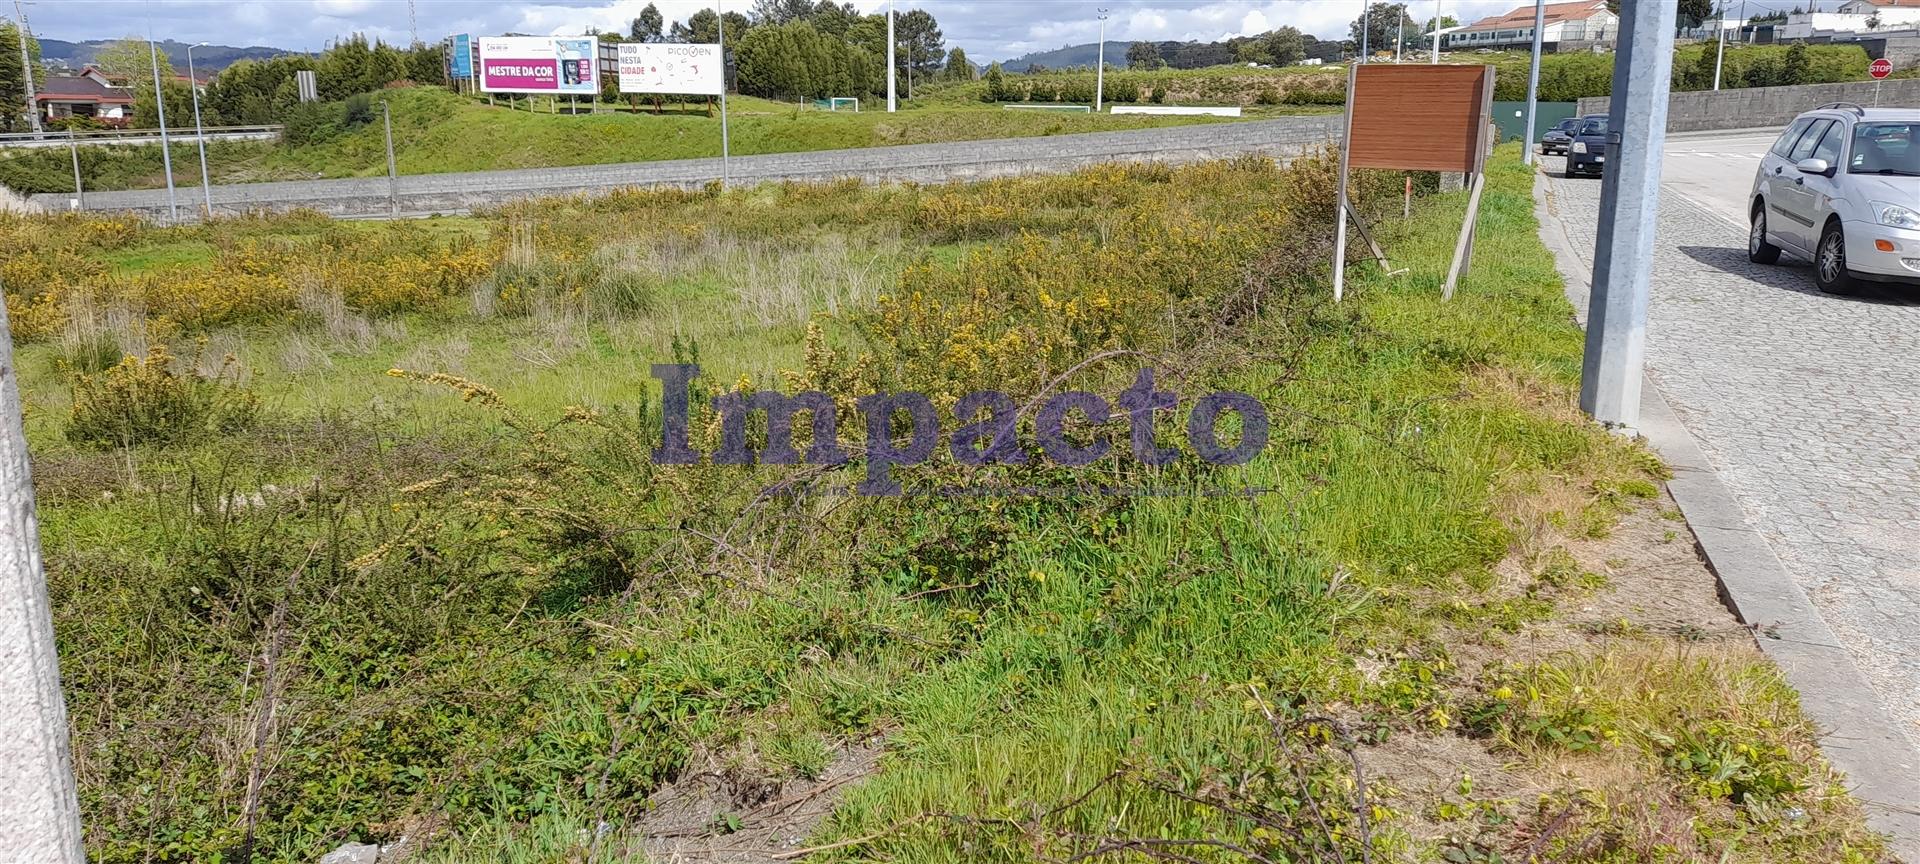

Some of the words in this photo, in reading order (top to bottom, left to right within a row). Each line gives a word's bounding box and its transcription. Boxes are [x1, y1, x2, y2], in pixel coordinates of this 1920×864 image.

[620, 46, 637, 54] TUDO
[620, 56, 641, 64] NESTA
[488, 66, 521, 76] MESTRE
[521, 66, 534, 76] DA
[534, 66, 553, 77] COR
[620, 67, 645, 75] CIDADE
